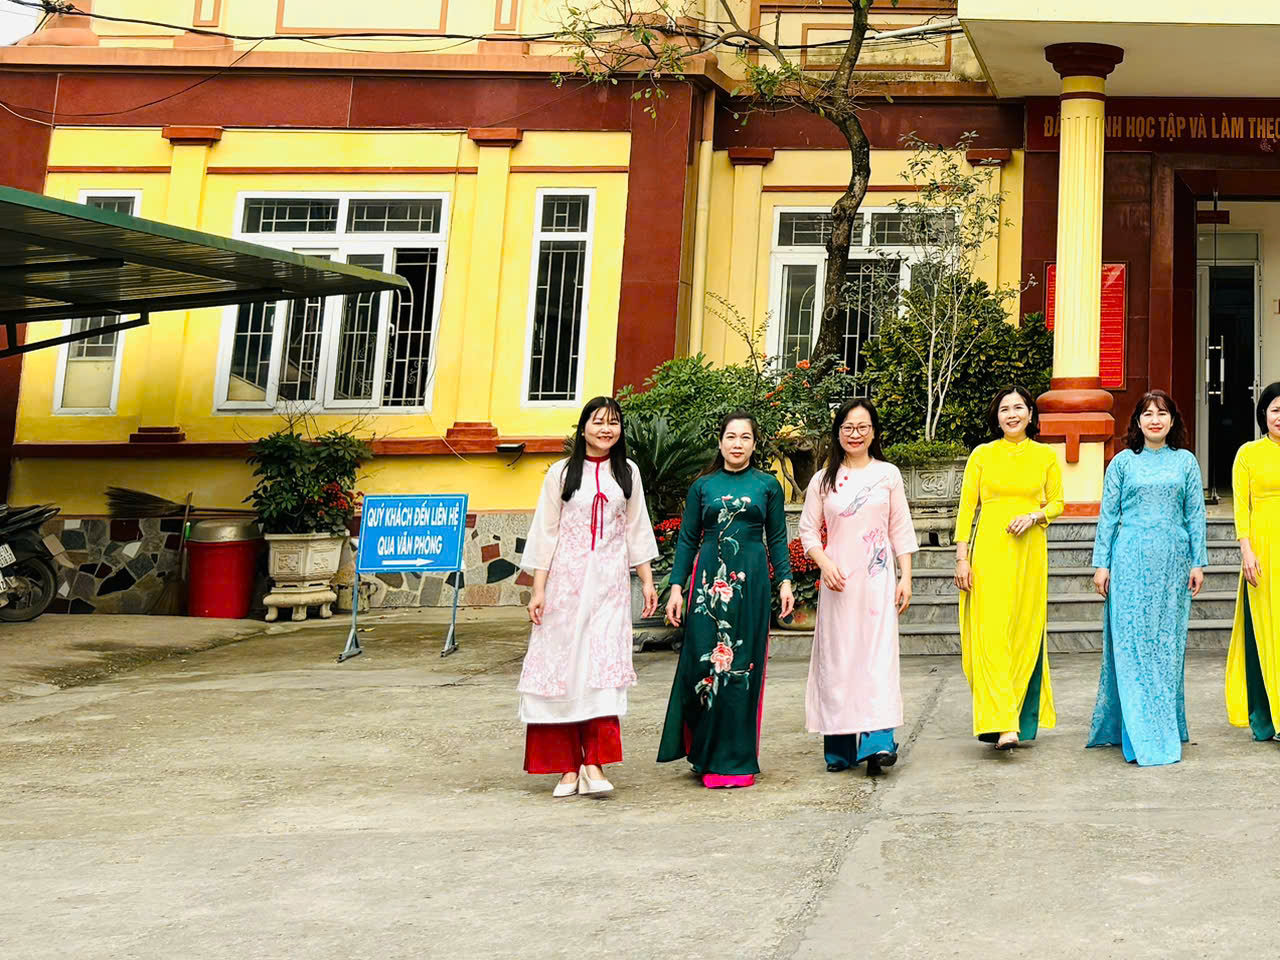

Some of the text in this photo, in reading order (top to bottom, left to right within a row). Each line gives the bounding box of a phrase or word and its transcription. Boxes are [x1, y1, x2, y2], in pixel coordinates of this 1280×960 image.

[1126, 116, 1155, 142] HỌC
[1159, 113, 1186, 142] TẬP
[1189, 113, 1207, 139] VÀ
[1212, 112, 1244, 139] LÀM
[367, 500, 460, 531] QUÝ KHÁCH ĐẾN LIÊN HỆ
[377, 530, 443, 556] QUA VĂN PHÒNG
